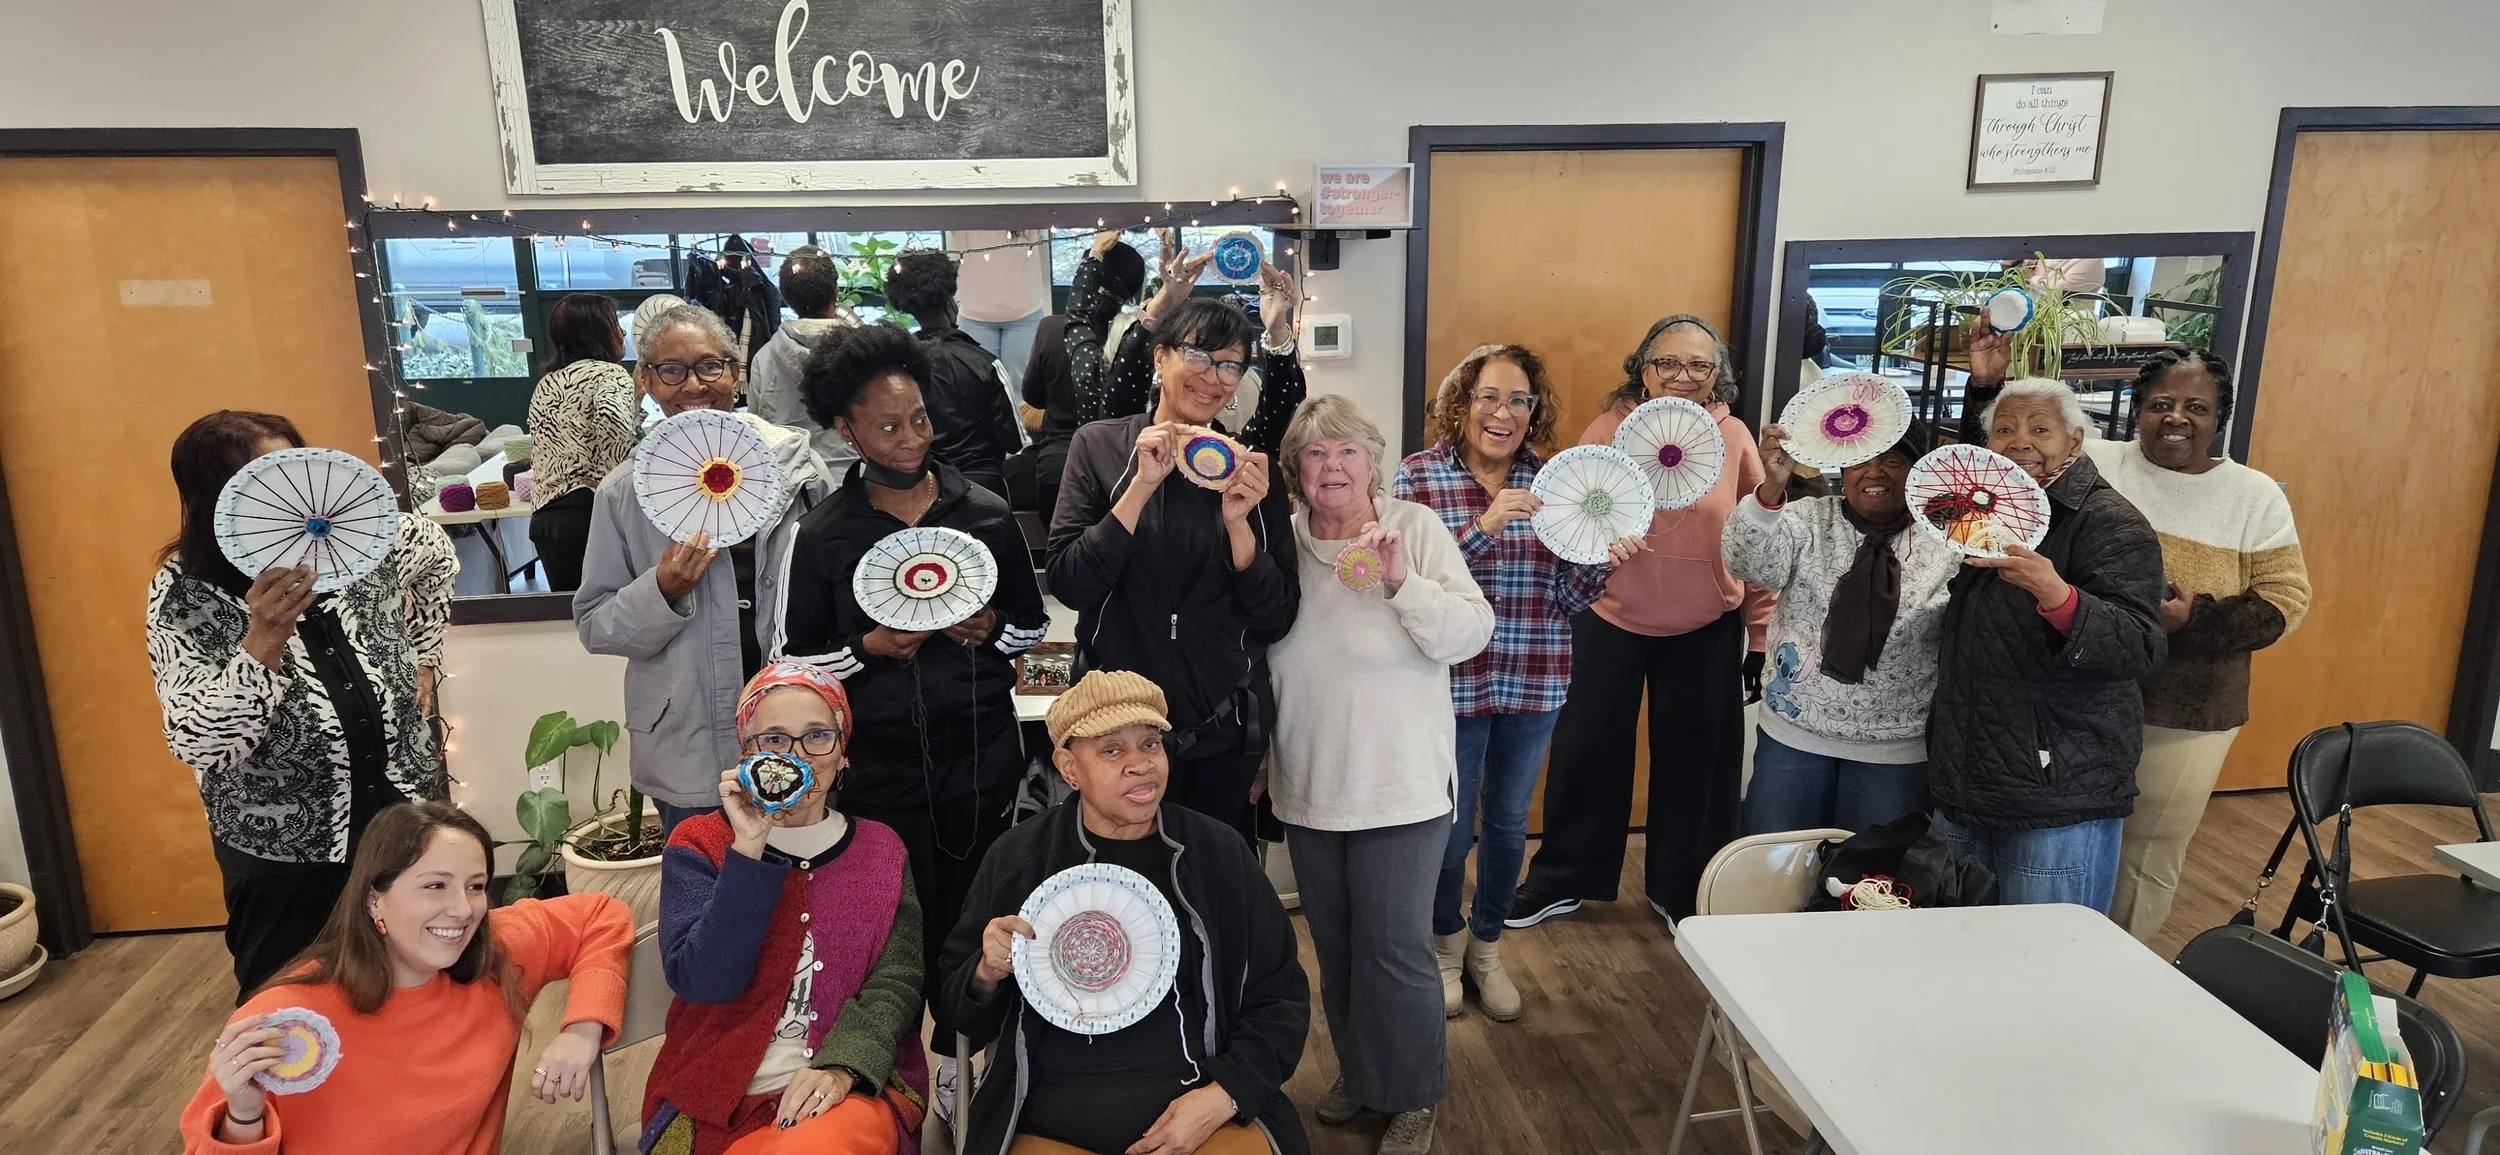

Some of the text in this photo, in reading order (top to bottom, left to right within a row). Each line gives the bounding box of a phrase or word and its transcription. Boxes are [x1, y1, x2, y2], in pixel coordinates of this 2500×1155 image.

[654, 0, 981, 124] Welcome
[2036, 86, 2053, 95] can
[2015, 98, 2069, 110] do all things
[1984, 112, 2098, 141] through Christ
[1980, 141, 2092, 165] who strengthens me
[1320, 172, 1371, 185] we are
[1320, 202, 1384, 219] together
